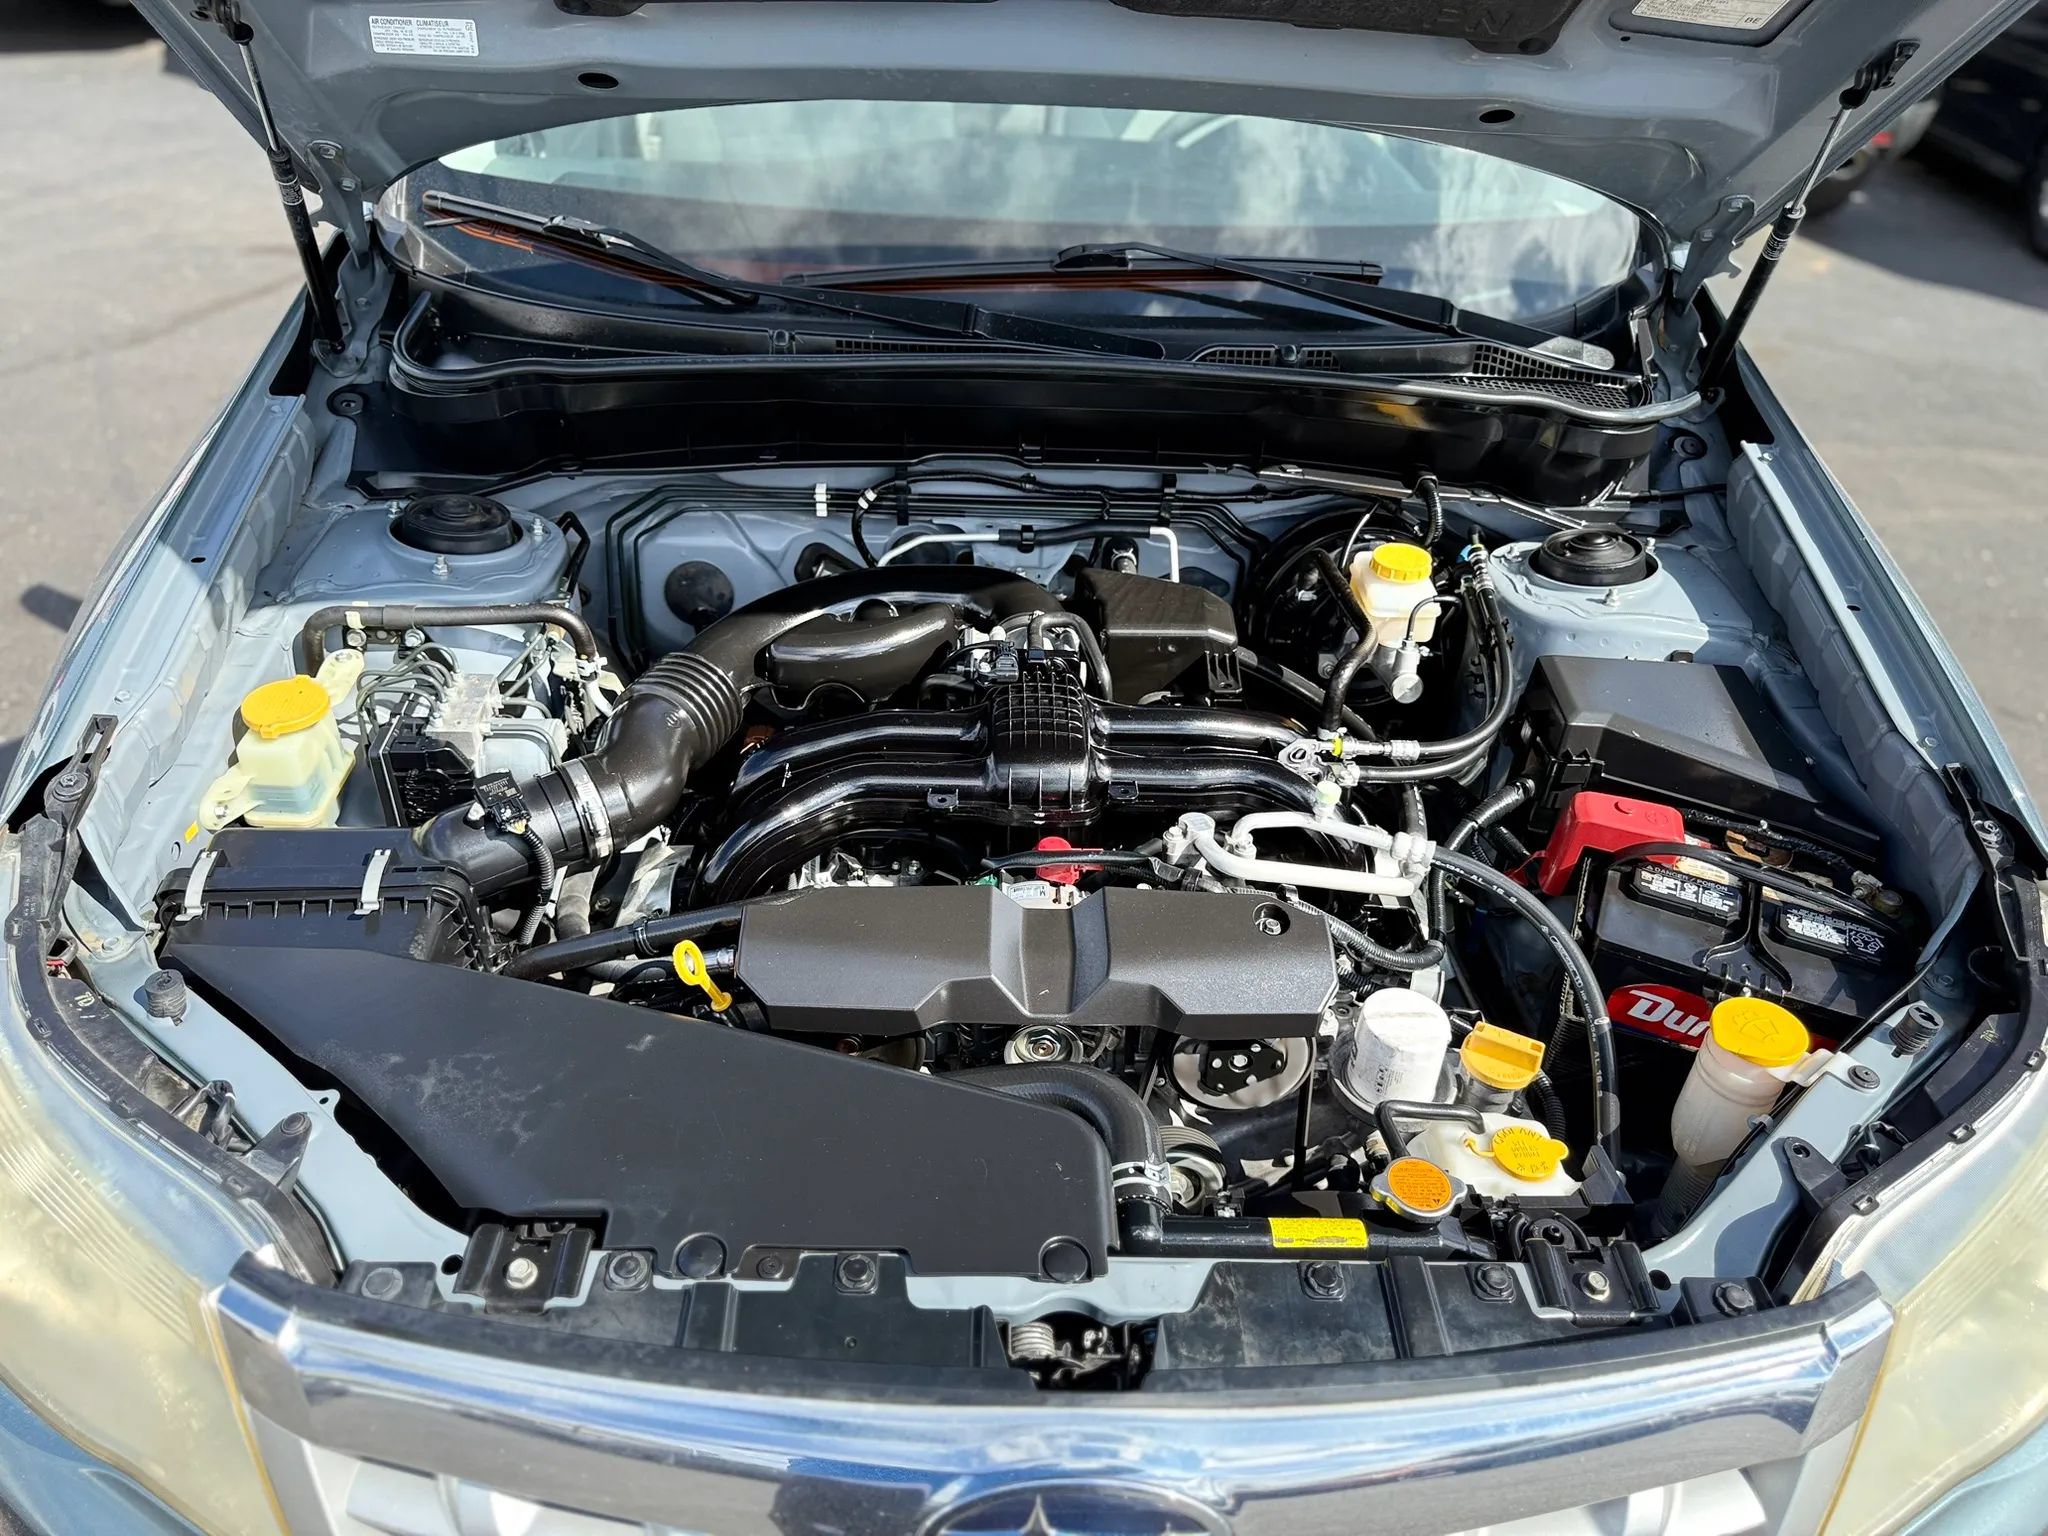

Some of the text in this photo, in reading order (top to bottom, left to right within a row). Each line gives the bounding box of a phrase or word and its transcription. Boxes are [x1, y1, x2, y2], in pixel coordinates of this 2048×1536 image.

[380, 18, 413, 26] CONDITIONER
[416, 19, 449, 27] CLIMATISEUR
[1654, 867, 1688, 881] DANGER
[1696, 879, 1728, 892] POISON
